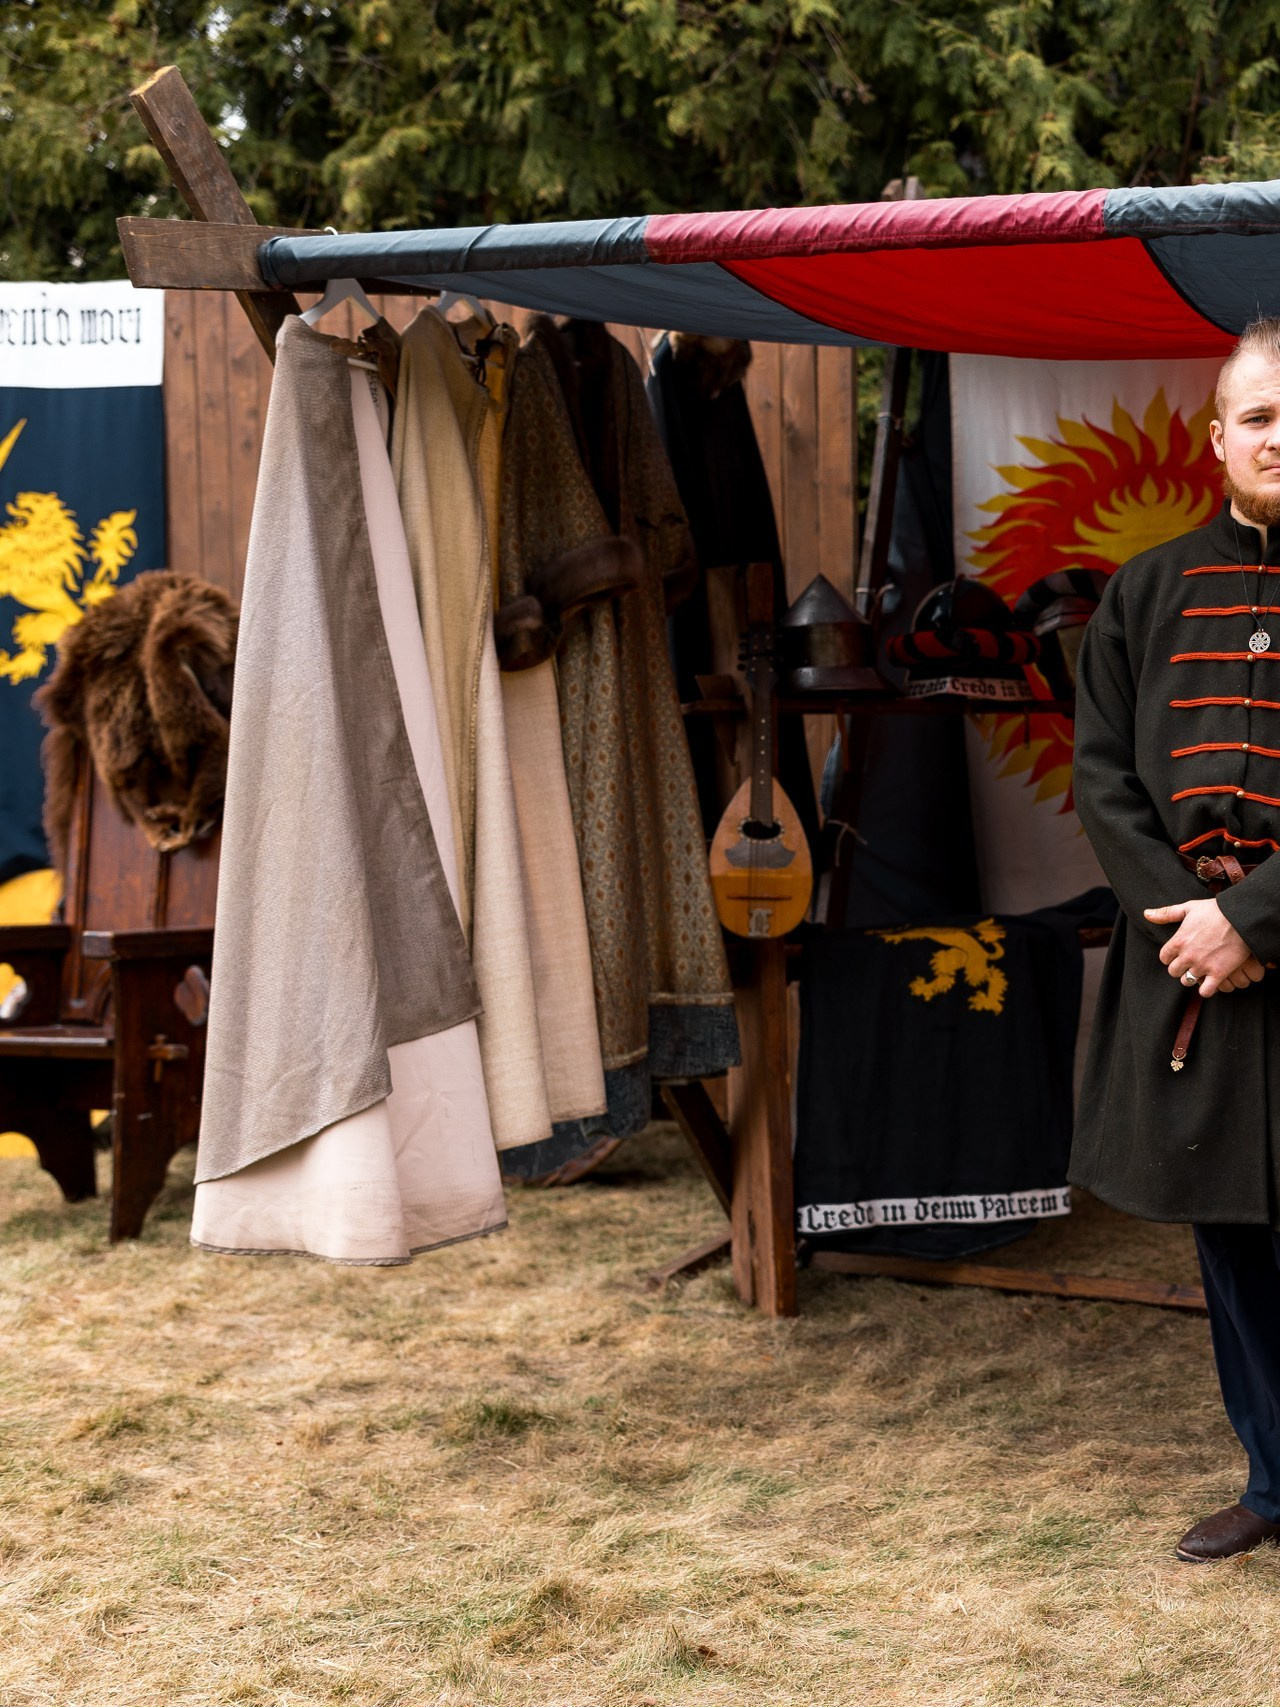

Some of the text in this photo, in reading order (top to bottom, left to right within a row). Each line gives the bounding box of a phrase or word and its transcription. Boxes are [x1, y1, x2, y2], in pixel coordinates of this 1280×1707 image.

[79, 307, 142, 346] mori
[951, 677, 996, 697] Credo
[881, 1204, 906, 1222] in
